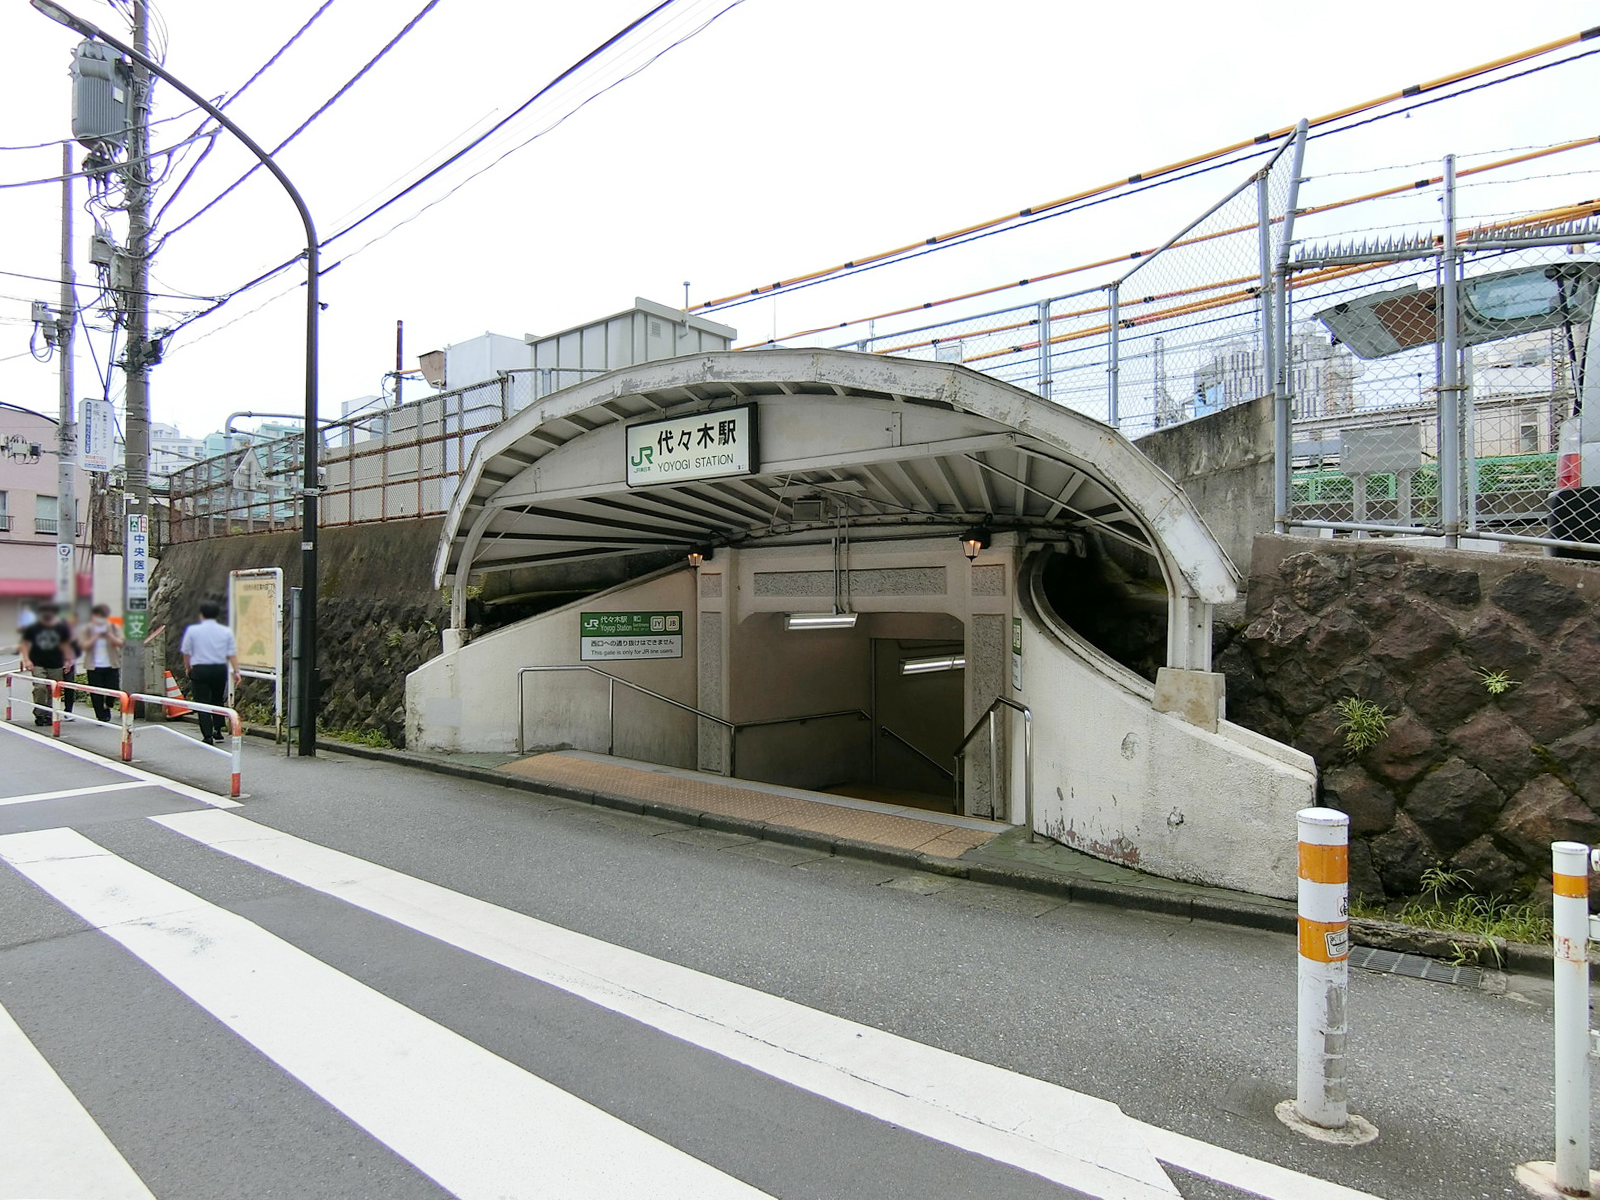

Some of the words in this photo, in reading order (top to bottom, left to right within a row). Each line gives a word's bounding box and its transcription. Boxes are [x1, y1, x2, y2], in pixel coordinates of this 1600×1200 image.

[658, 419, 737, 456] 代々木駅
[631, 445, 654, 467] JR
[657, 459, 691, 473] YOYOGI
[695, 453, 734, 469] STATION
[133, 533, 146, 583] 中央医院
[584, 619, 599, 628] JR
[600, 615, 628, 623] 代々木駅
[653, 619, 662, 628] JY
[669, 619, 677, 627] JB
[600, 623, 616, 633] Yoyogi
[616, 623, 632, 632] Station
[591, 639, 674, 647] 西口への通り抜けはできません
[623, 649, 633, 657] only
